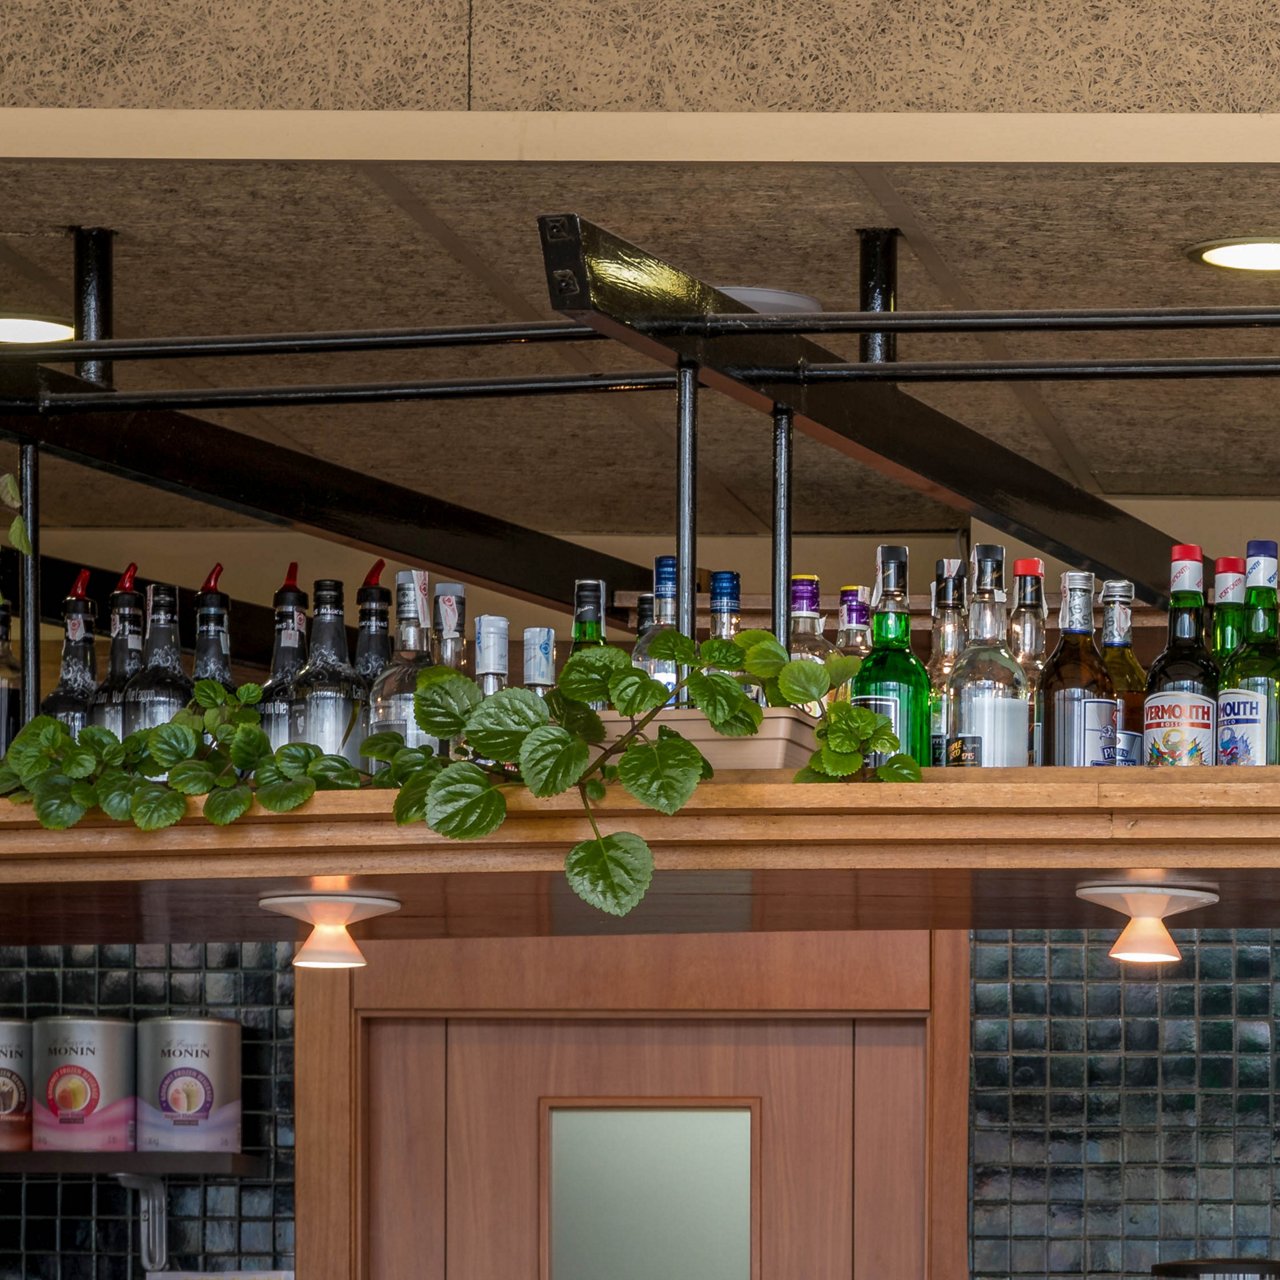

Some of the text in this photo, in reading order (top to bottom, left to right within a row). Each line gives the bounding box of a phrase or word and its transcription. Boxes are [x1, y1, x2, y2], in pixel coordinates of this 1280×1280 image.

[1144, 704, 1211, 722] VERMOUTH
[48, 1046, 96, 1057] MONIN
[160, 1048, 210, 1059] MONIN
